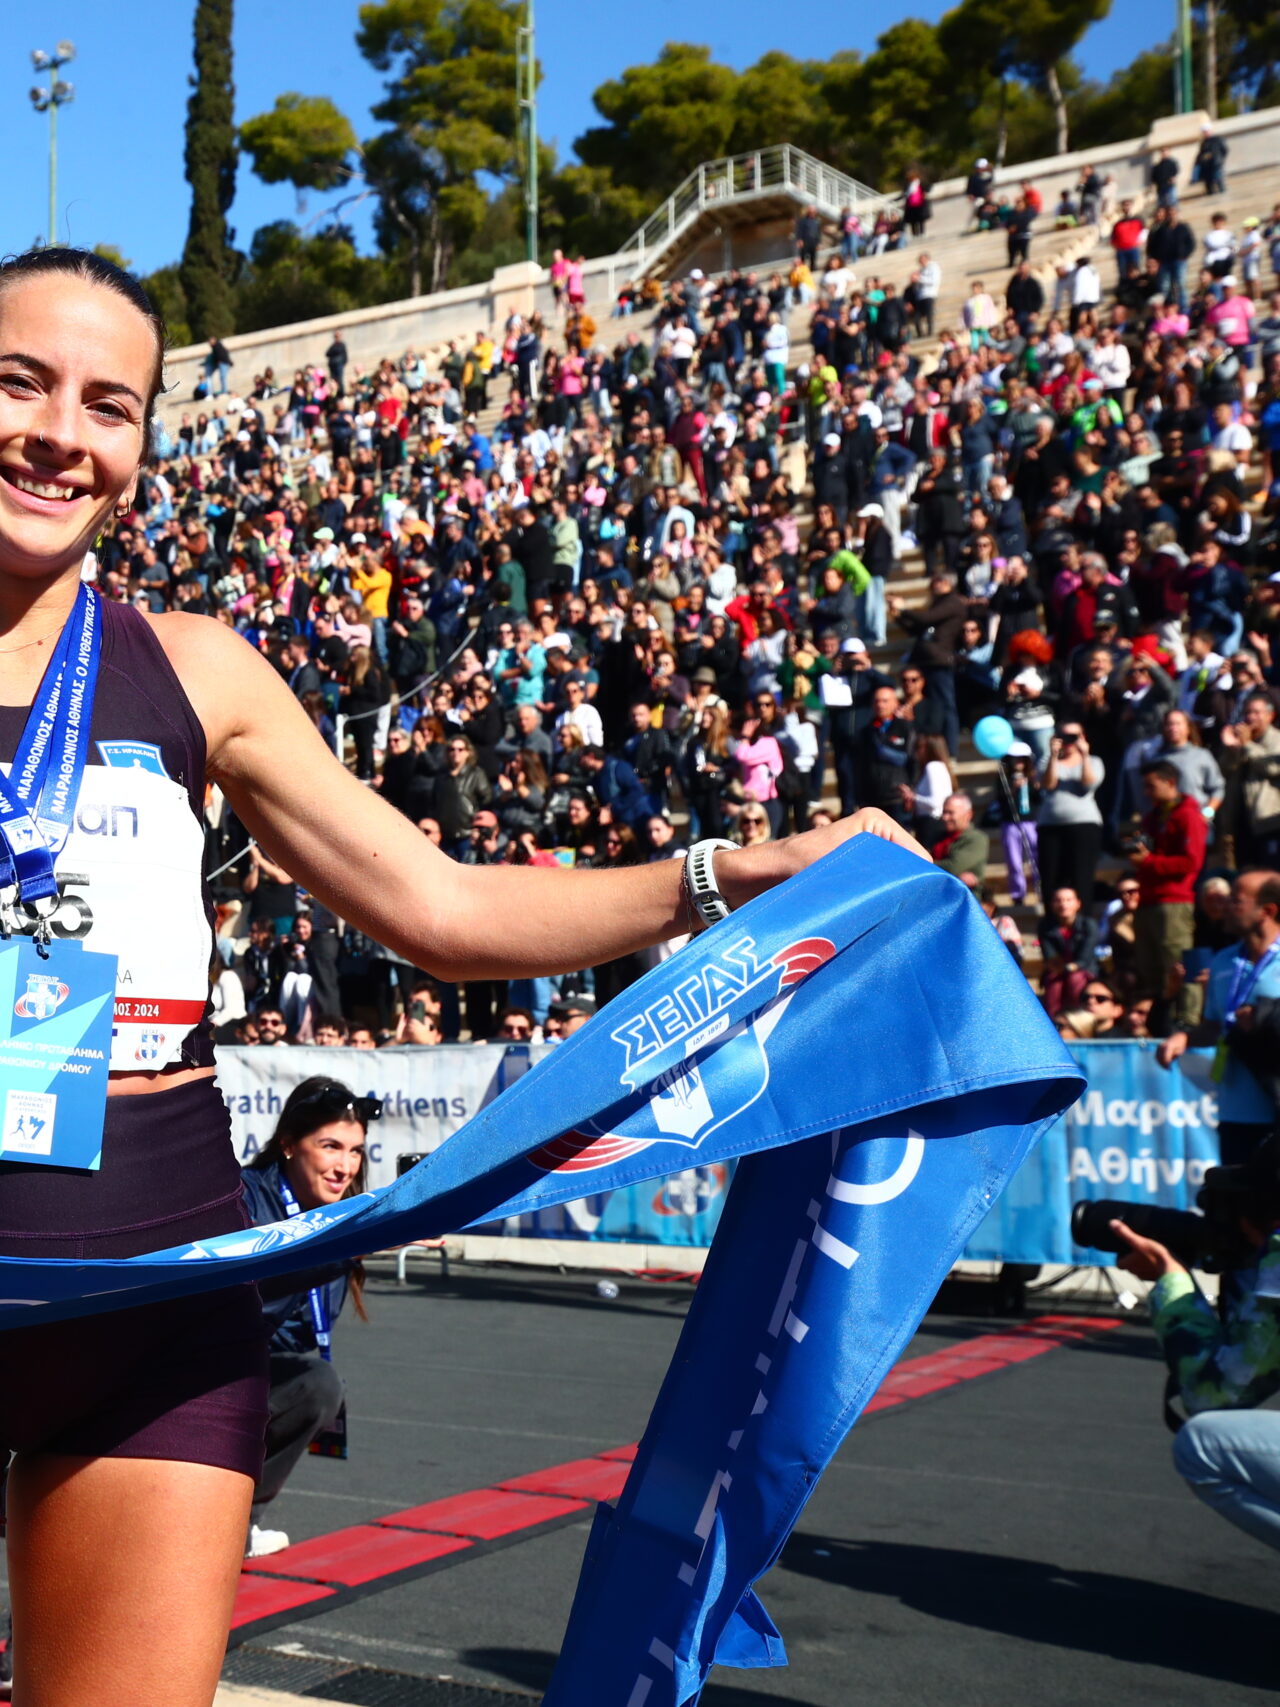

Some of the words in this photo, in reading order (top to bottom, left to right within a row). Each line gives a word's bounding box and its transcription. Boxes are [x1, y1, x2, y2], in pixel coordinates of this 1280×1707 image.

[16, 720, 54, 800] ΜΑΡΑΘΩΝΙΟΣ
[50, 727, 81, 815] ΜΑΡΑΘΩΝΙΟΣ
[66, 680, 88, 729] ΑΘΗΝΑΣ.
[134, 1004, 160, 1017] 2024
[611, 936, 757, 1055] ΣΕΓΑΣ
